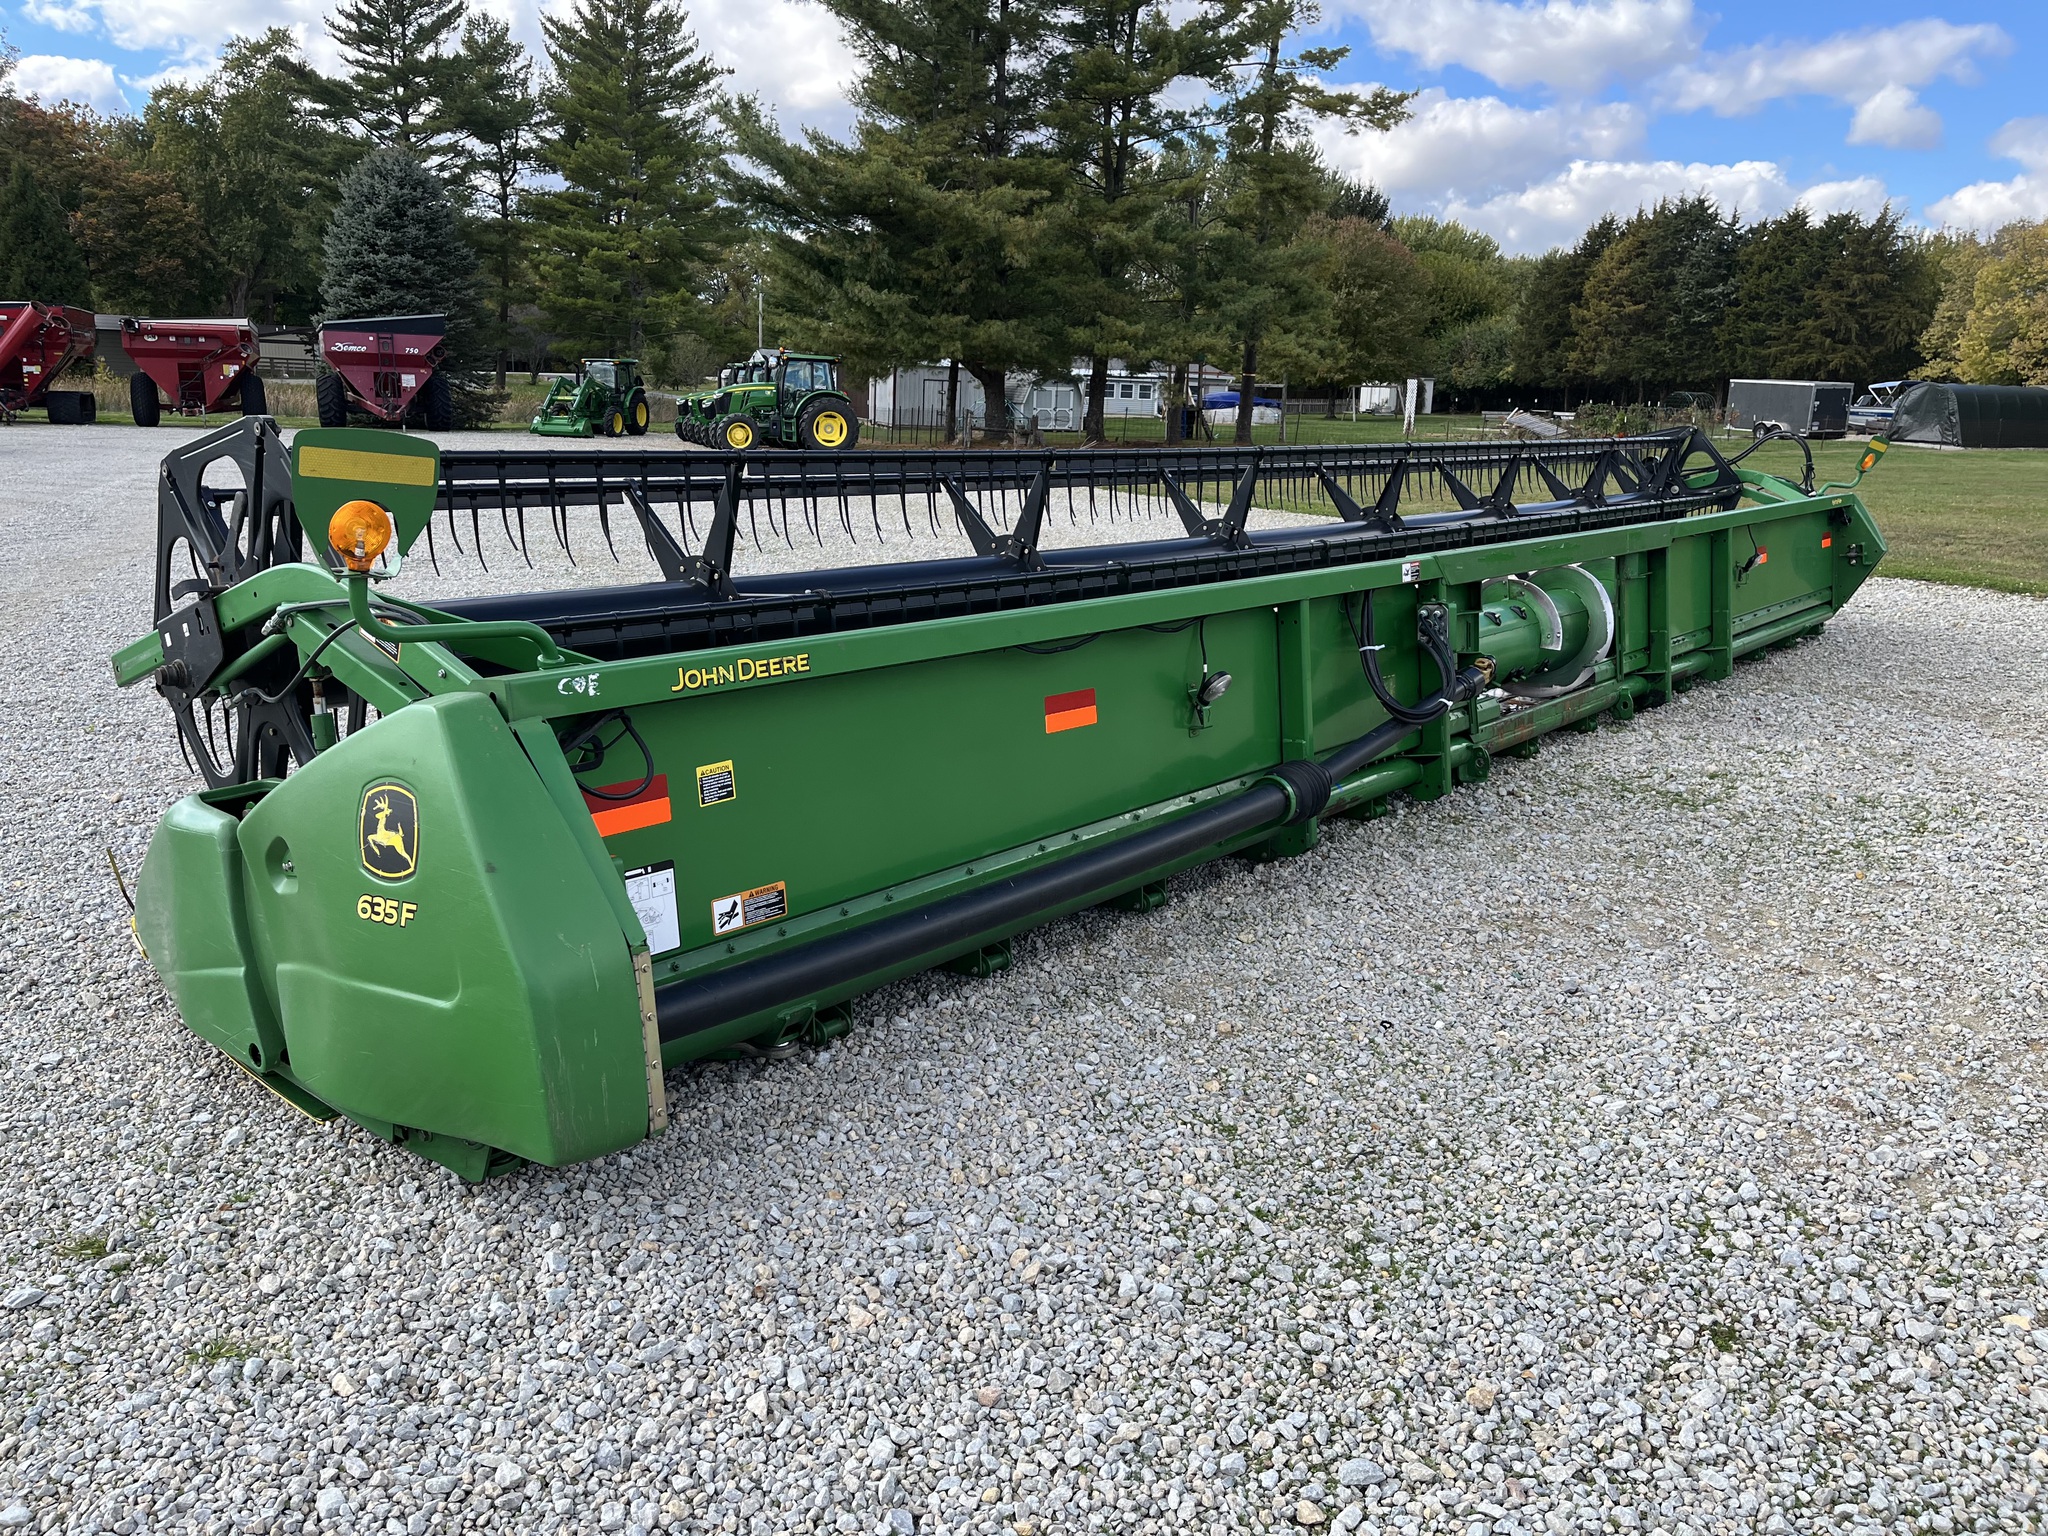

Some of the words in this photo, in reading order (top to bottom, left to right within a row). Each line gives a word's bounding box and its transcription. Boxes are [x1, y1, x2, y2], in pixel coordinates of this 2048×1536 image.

[331, 342, 367, 353] Demco
[671, 664, 735, 692] JOHN
[736, 653, 811, 683] DEERE
[705, 764, 730, 775] CAUTION
[754, 884, 779, 896] WARNING
[356, 893, 418, 928] 635F
